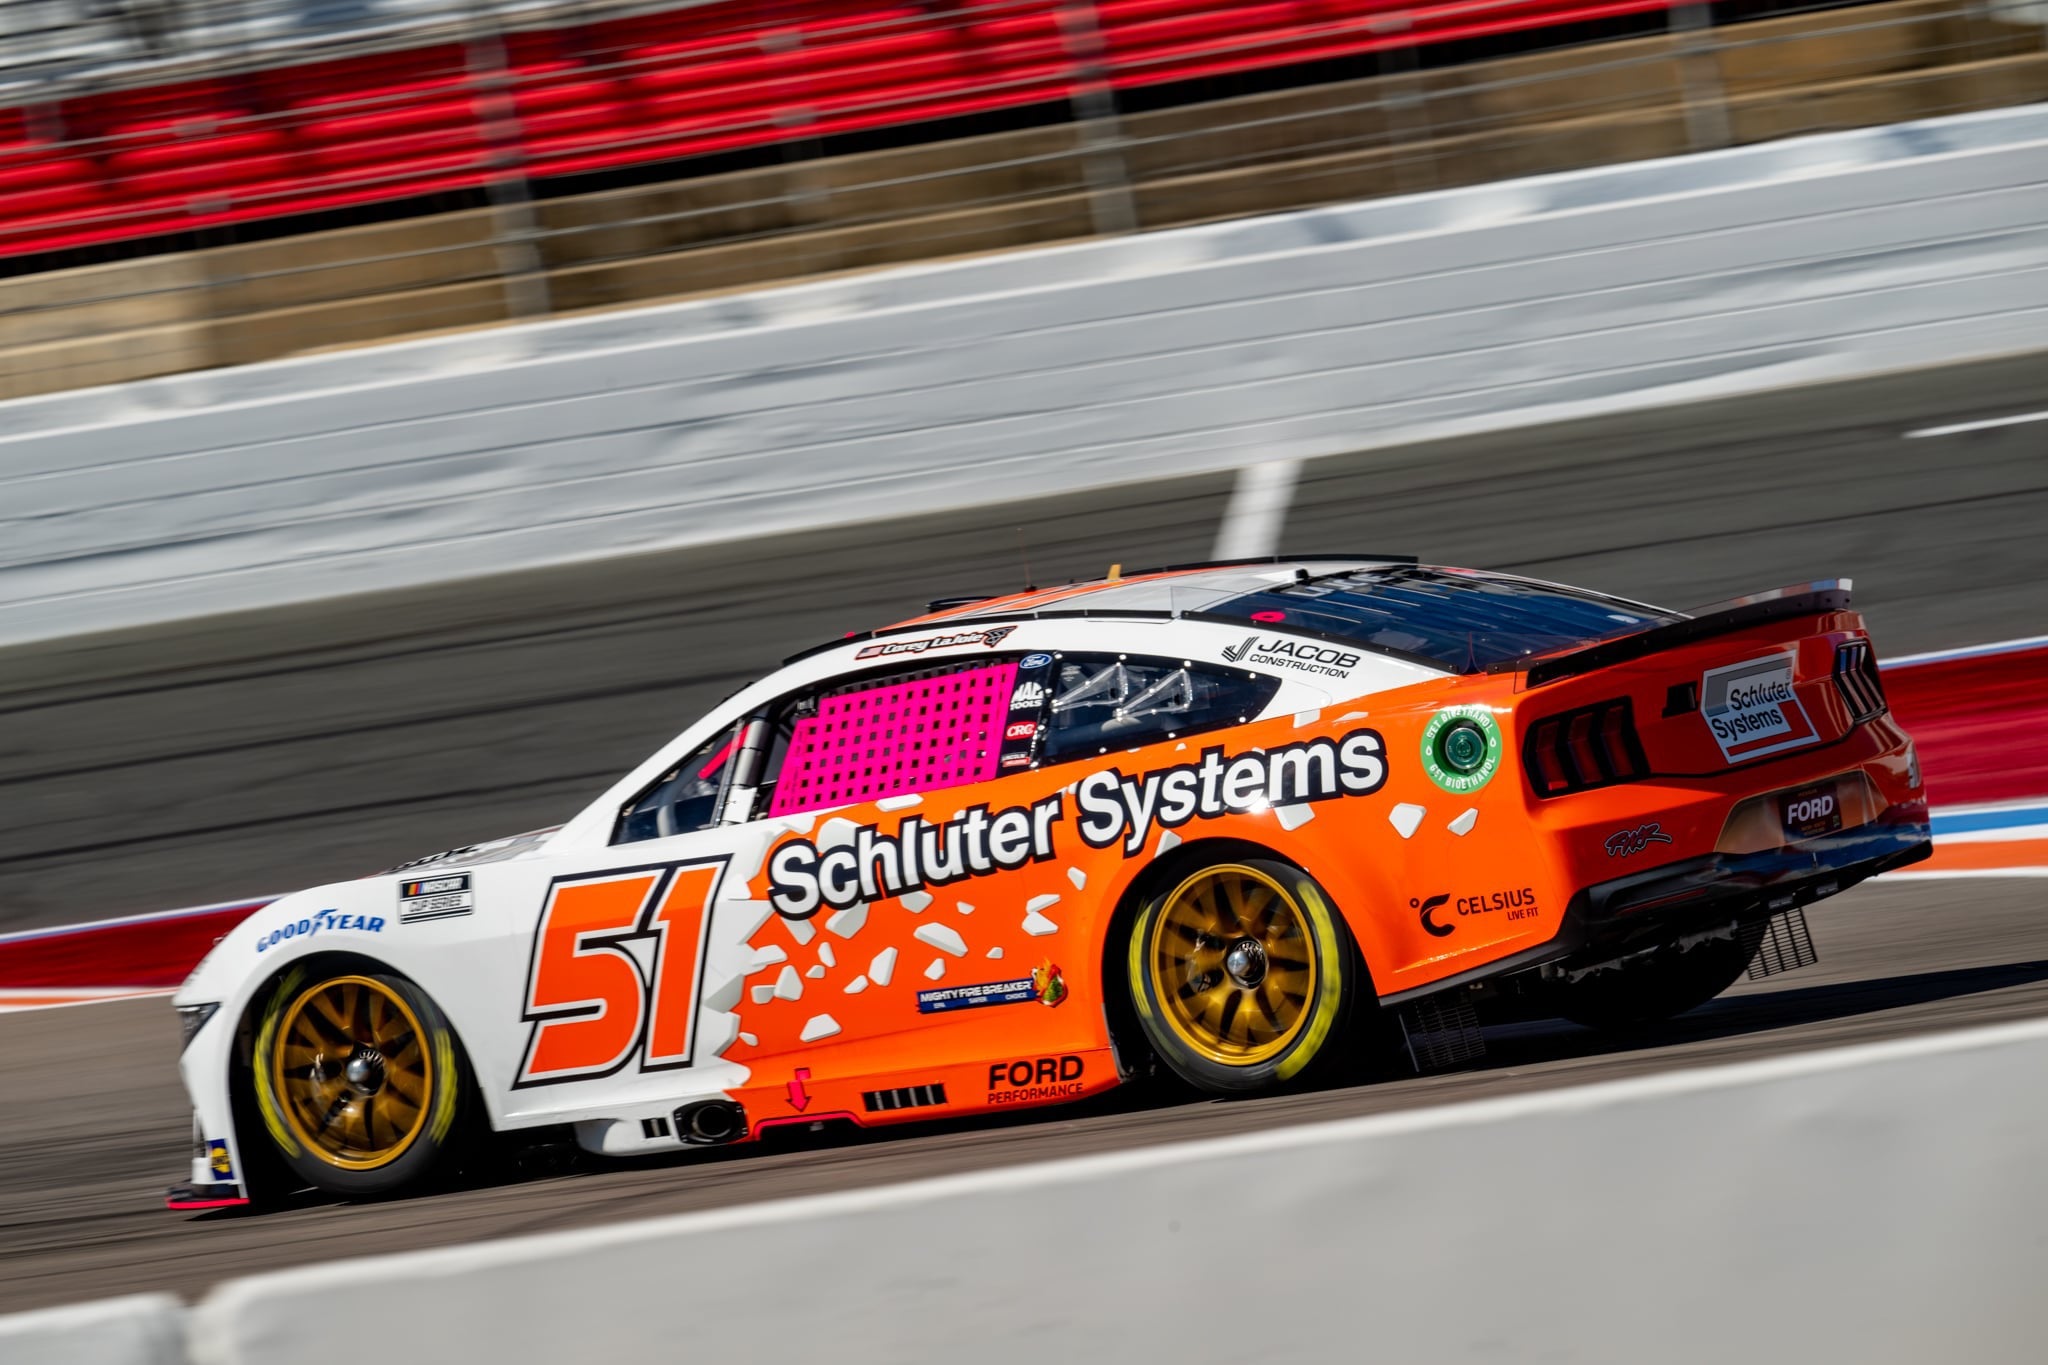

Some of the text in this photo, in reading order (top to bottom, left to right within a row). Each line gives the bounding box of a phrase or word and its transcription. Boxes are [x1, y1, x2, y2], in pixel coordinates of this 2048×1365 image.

[882, 632, 984, 653] Corey LaJoie
[1258, 640, 1361, 668] JACOB
[1249, 653, 1350, 679] CONSTRUCTION
[1010, 700, 1042, 711] TOOLS
[1731, 681, 1791, 711] Schluter
[1006, 723, 1035, 737] CRC
[1711, 708, 1783, 741] Systems
[1429, 756, 1496, 789] GET BIOETHANOL
[1787, 795, 1834, 825] FORD
[770, 734, 1385, 917] Schluter Systems
[424, 877, 464, 893] NASCAR
[409, 895, 462, 913] CUP SERIES
[1457, 888, 1535, 916] CELSIUS
[1507, 907, 1539, 921] LIVE FIT
[511, 853, 735, 1091] 51
[920, 990, 959, 1002] MIGHTY
[960, 986, 982, 998] FIRE
[989, 1056, 1084, 1090] FORD
[988, 1083, 1083, 1104] PERFORMANCE
